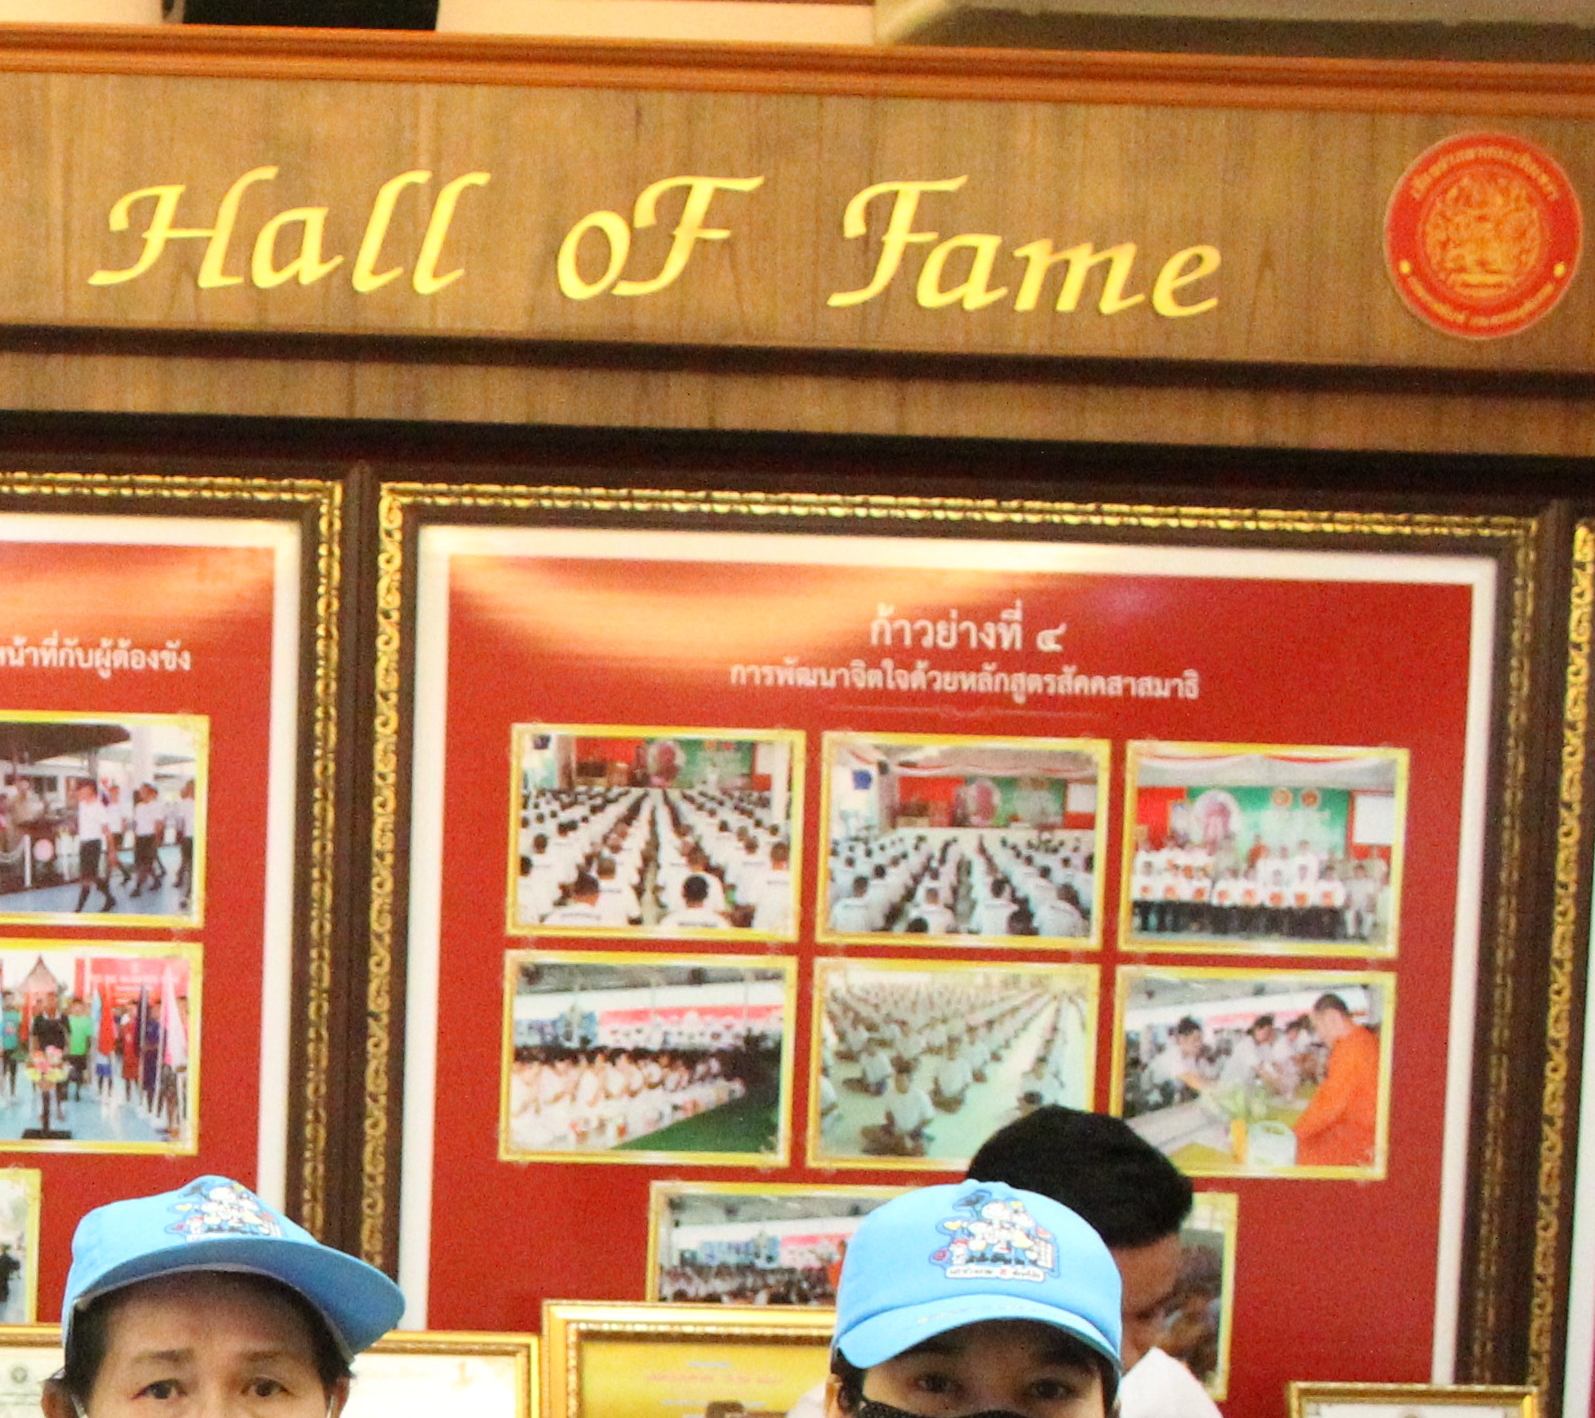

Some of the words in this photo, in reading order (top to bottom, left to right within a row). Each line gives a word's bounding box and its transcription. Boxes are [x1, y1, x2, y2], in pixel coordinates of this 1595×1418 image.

[86, 162, 492, 299] Hall
[825, 174, 1222, 319] Fame
[869, 600, 1023, 651] ก้าวย่างที่
